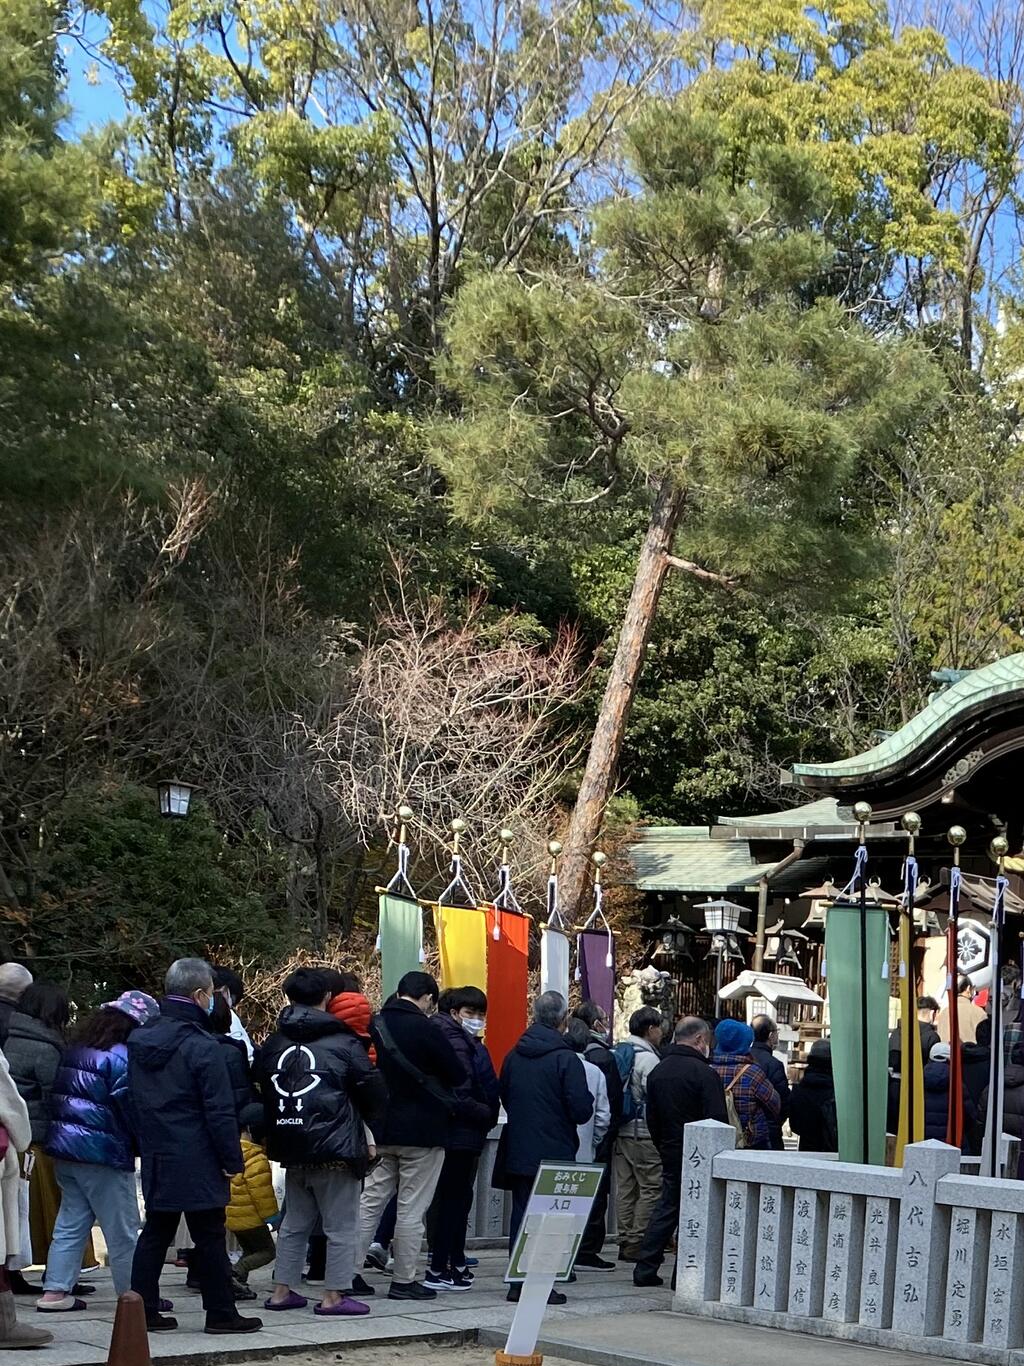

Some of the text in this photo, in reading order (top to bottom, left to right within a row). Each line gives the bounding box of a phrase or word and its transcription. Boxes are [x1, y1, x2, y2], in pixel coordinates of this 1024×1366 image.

[549, 1198, 571, 1211] 入口
[554, 1171, 587, 1182] おみくじ
[685, 1146, 706, 1269] 今村聖三
[903, 1170, 928, 1303] 八代吉弘
